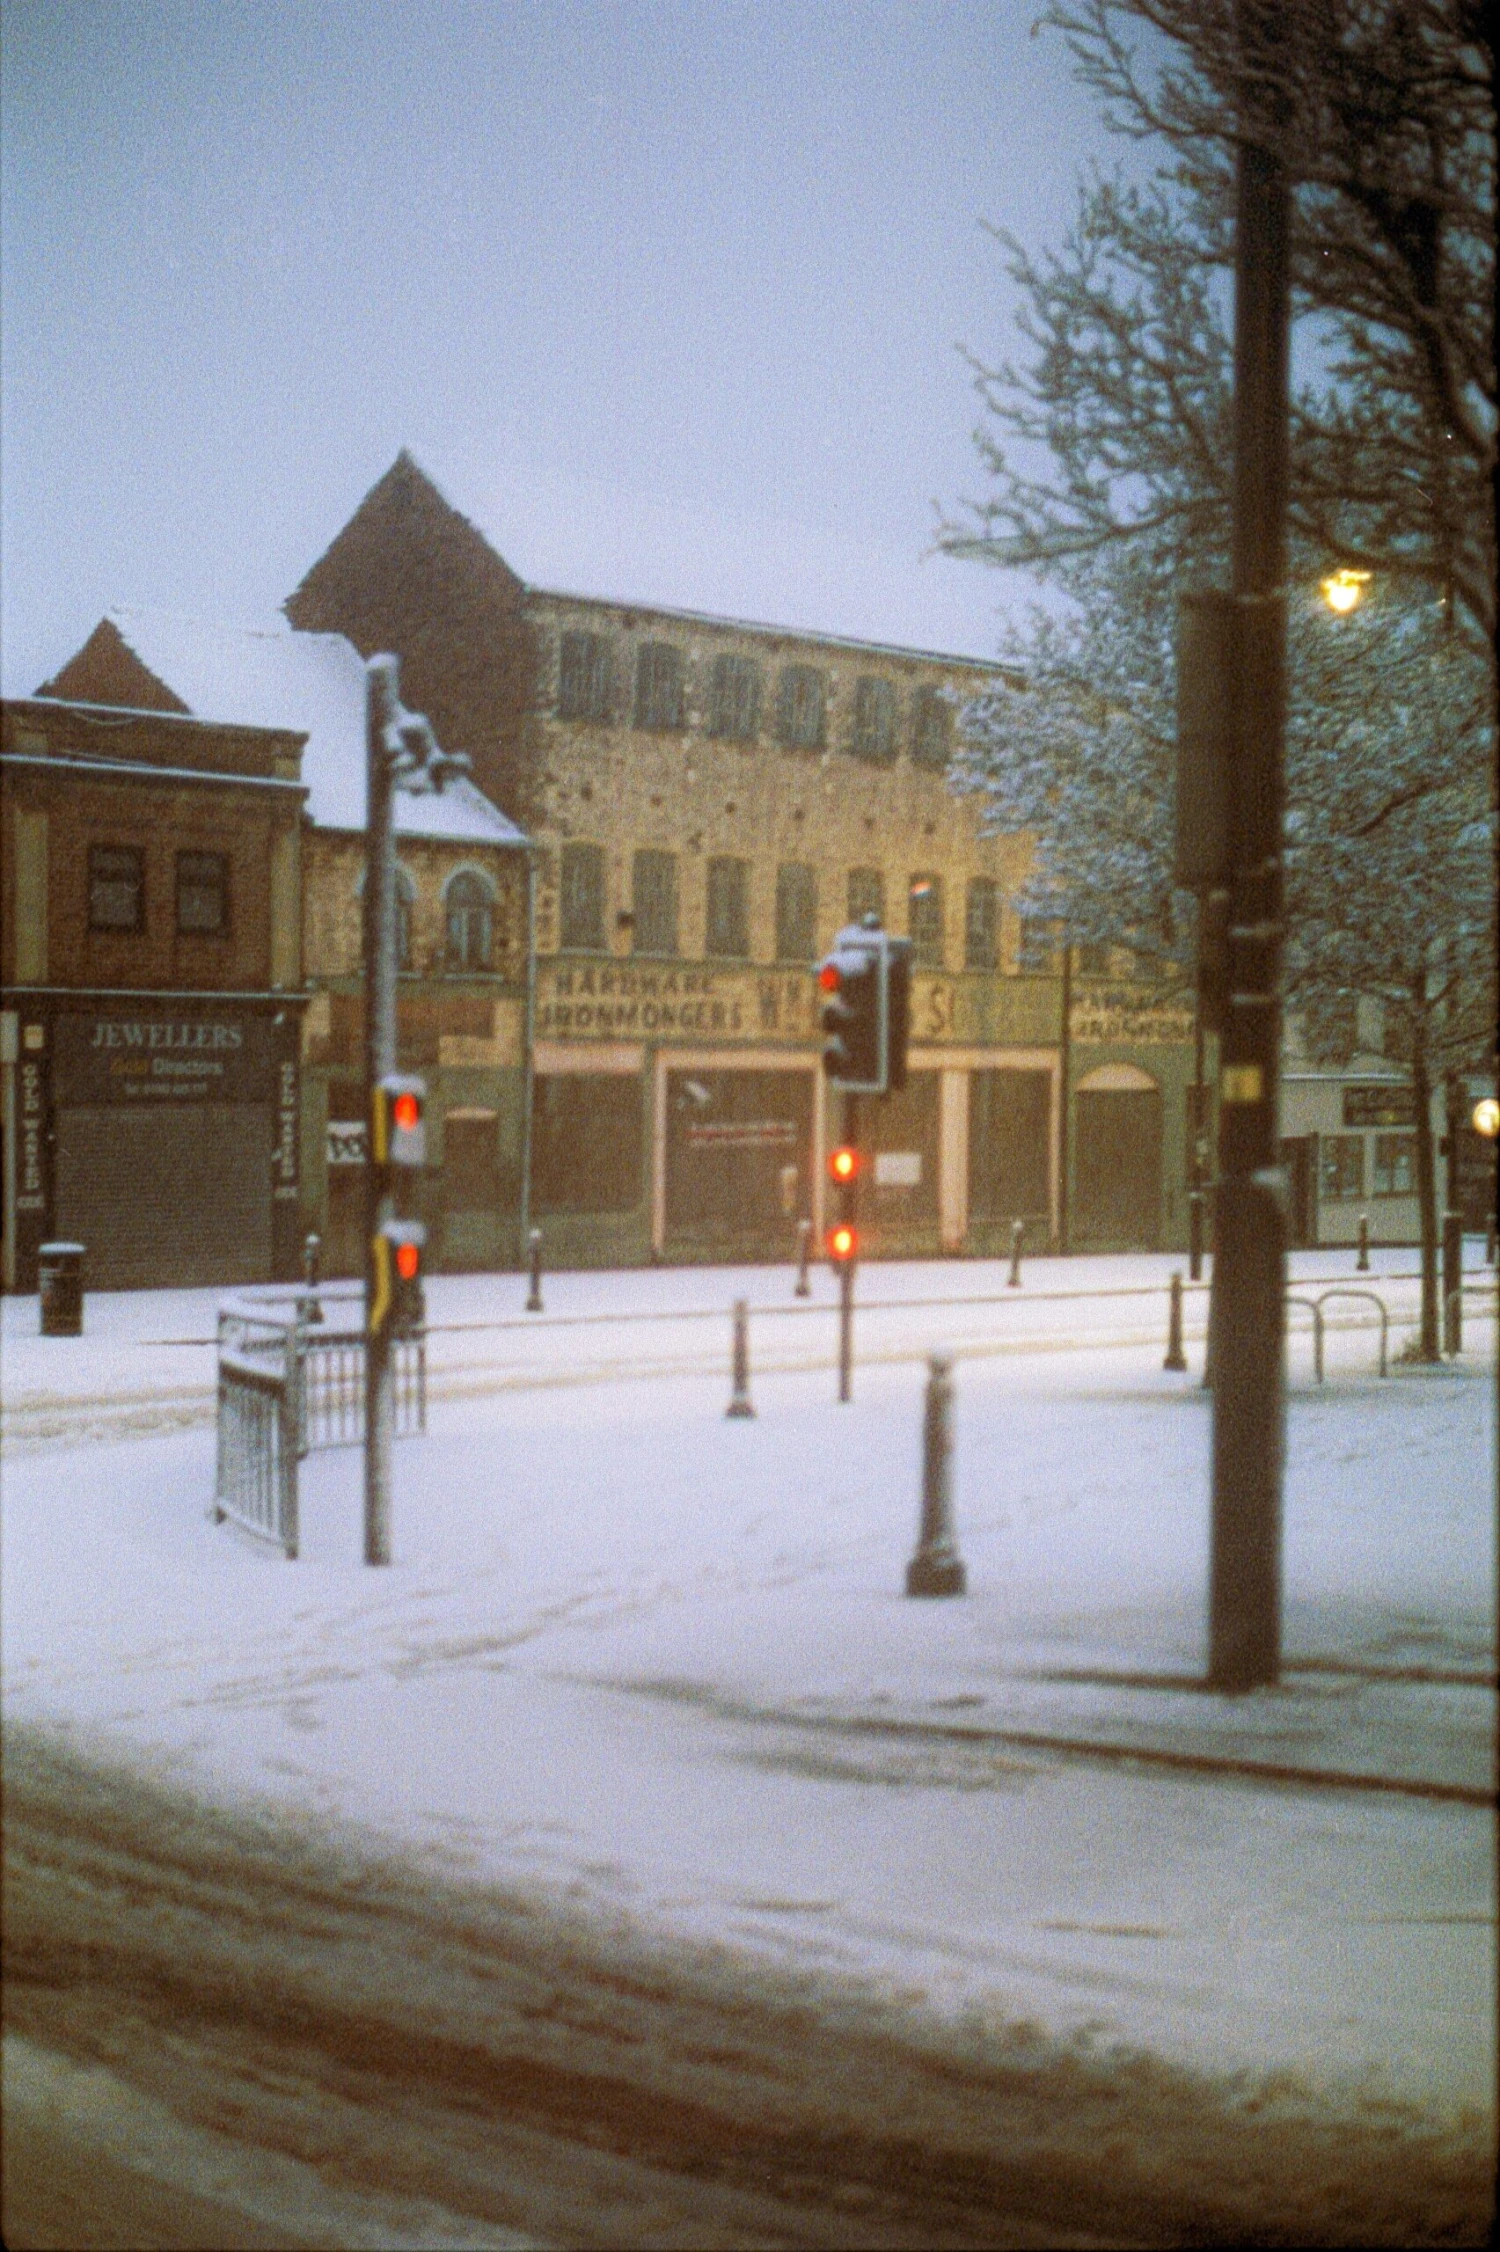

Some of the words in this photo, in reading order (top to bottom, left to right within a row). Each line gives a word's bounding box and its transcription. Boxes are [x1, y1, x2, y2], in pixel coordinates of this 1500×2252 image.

[92, 1023, 243, 1048] JEWELLERS
[22, 1064, 40, 1111] GOLD
[22, 1118, 41, 1190] WANTED
